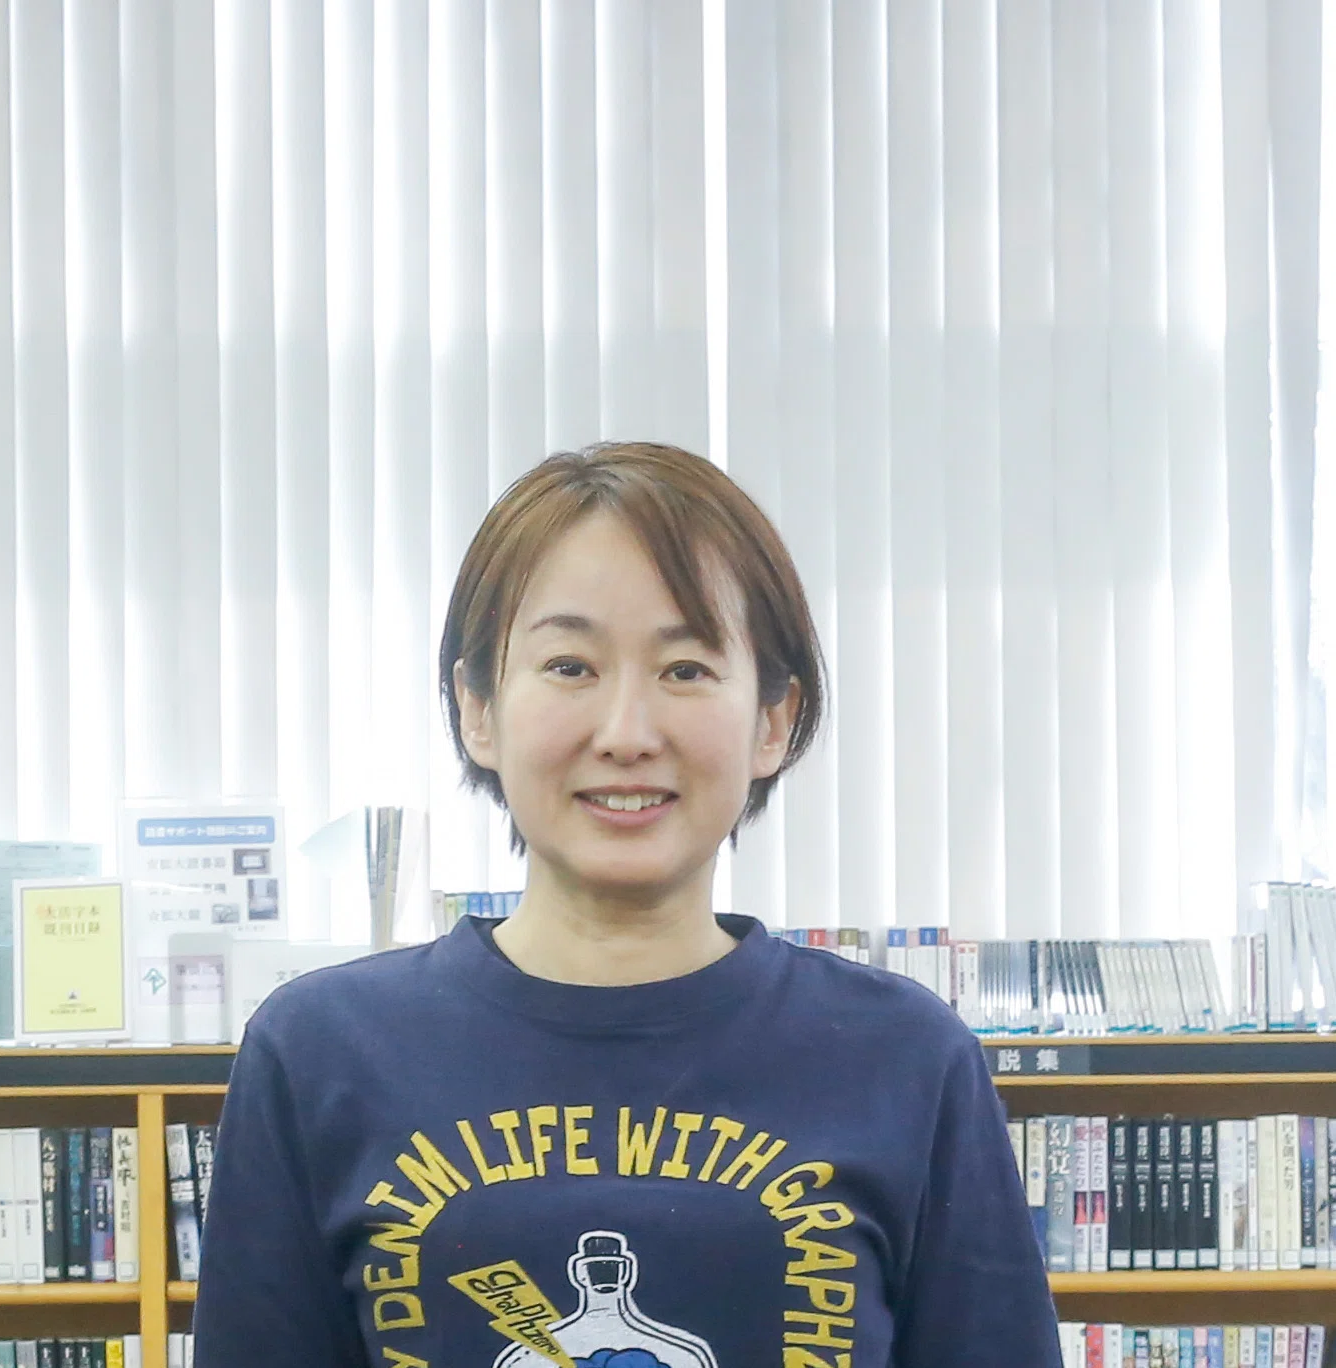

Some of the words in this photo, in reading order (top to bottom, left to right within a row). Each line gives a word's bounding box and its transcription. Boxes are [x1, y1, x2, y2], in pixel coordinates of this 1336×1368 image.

[364, 1130, 473, 1332] DENIM
[456, 1104, 600, 1186] LIFE
[616, 1105, 789, 1191] WITH
